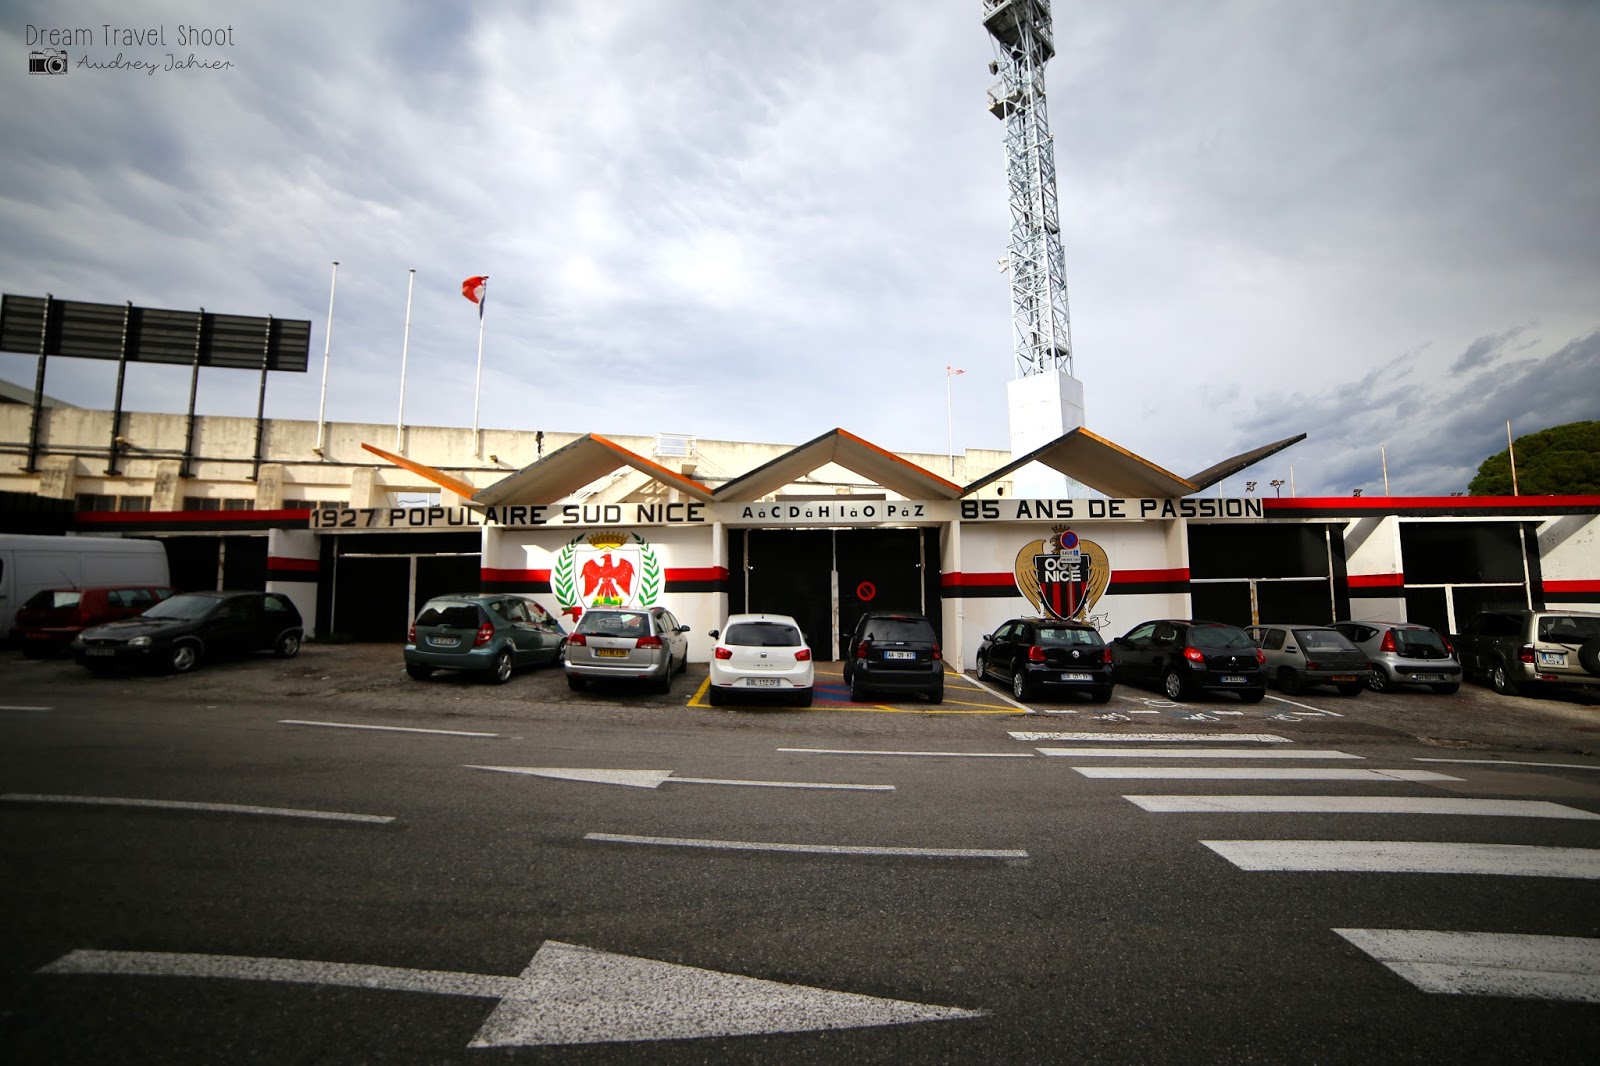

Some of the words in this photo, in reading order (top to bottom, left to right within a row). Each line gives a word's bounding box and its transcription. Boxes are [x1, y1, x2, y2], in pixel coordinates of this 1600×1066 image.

[742, 506, 753, 518] A
[771, 506, 781, 518] C
[789, 506, 800, 518] D
[818, 506, 830, 518] H
[863, 505, 876, 517] O
[887, 505, 897, 517] P
[914, 504, 924, 517] Z
[961, 500, 1000, 519] 85
[1016, 499, 1074, 519] ANS
[1089, 499, 1126, 518] DE
[1140, 498, 1262, 518] PASSION
[311, 509, 376, 527] 1927
[389, 505, 548, 527] POPULAIRE
[562, 504, 621, 524] SUD
[637, 503, 705, 523] NICE
[1045, 570, 1081, 582] NICE
